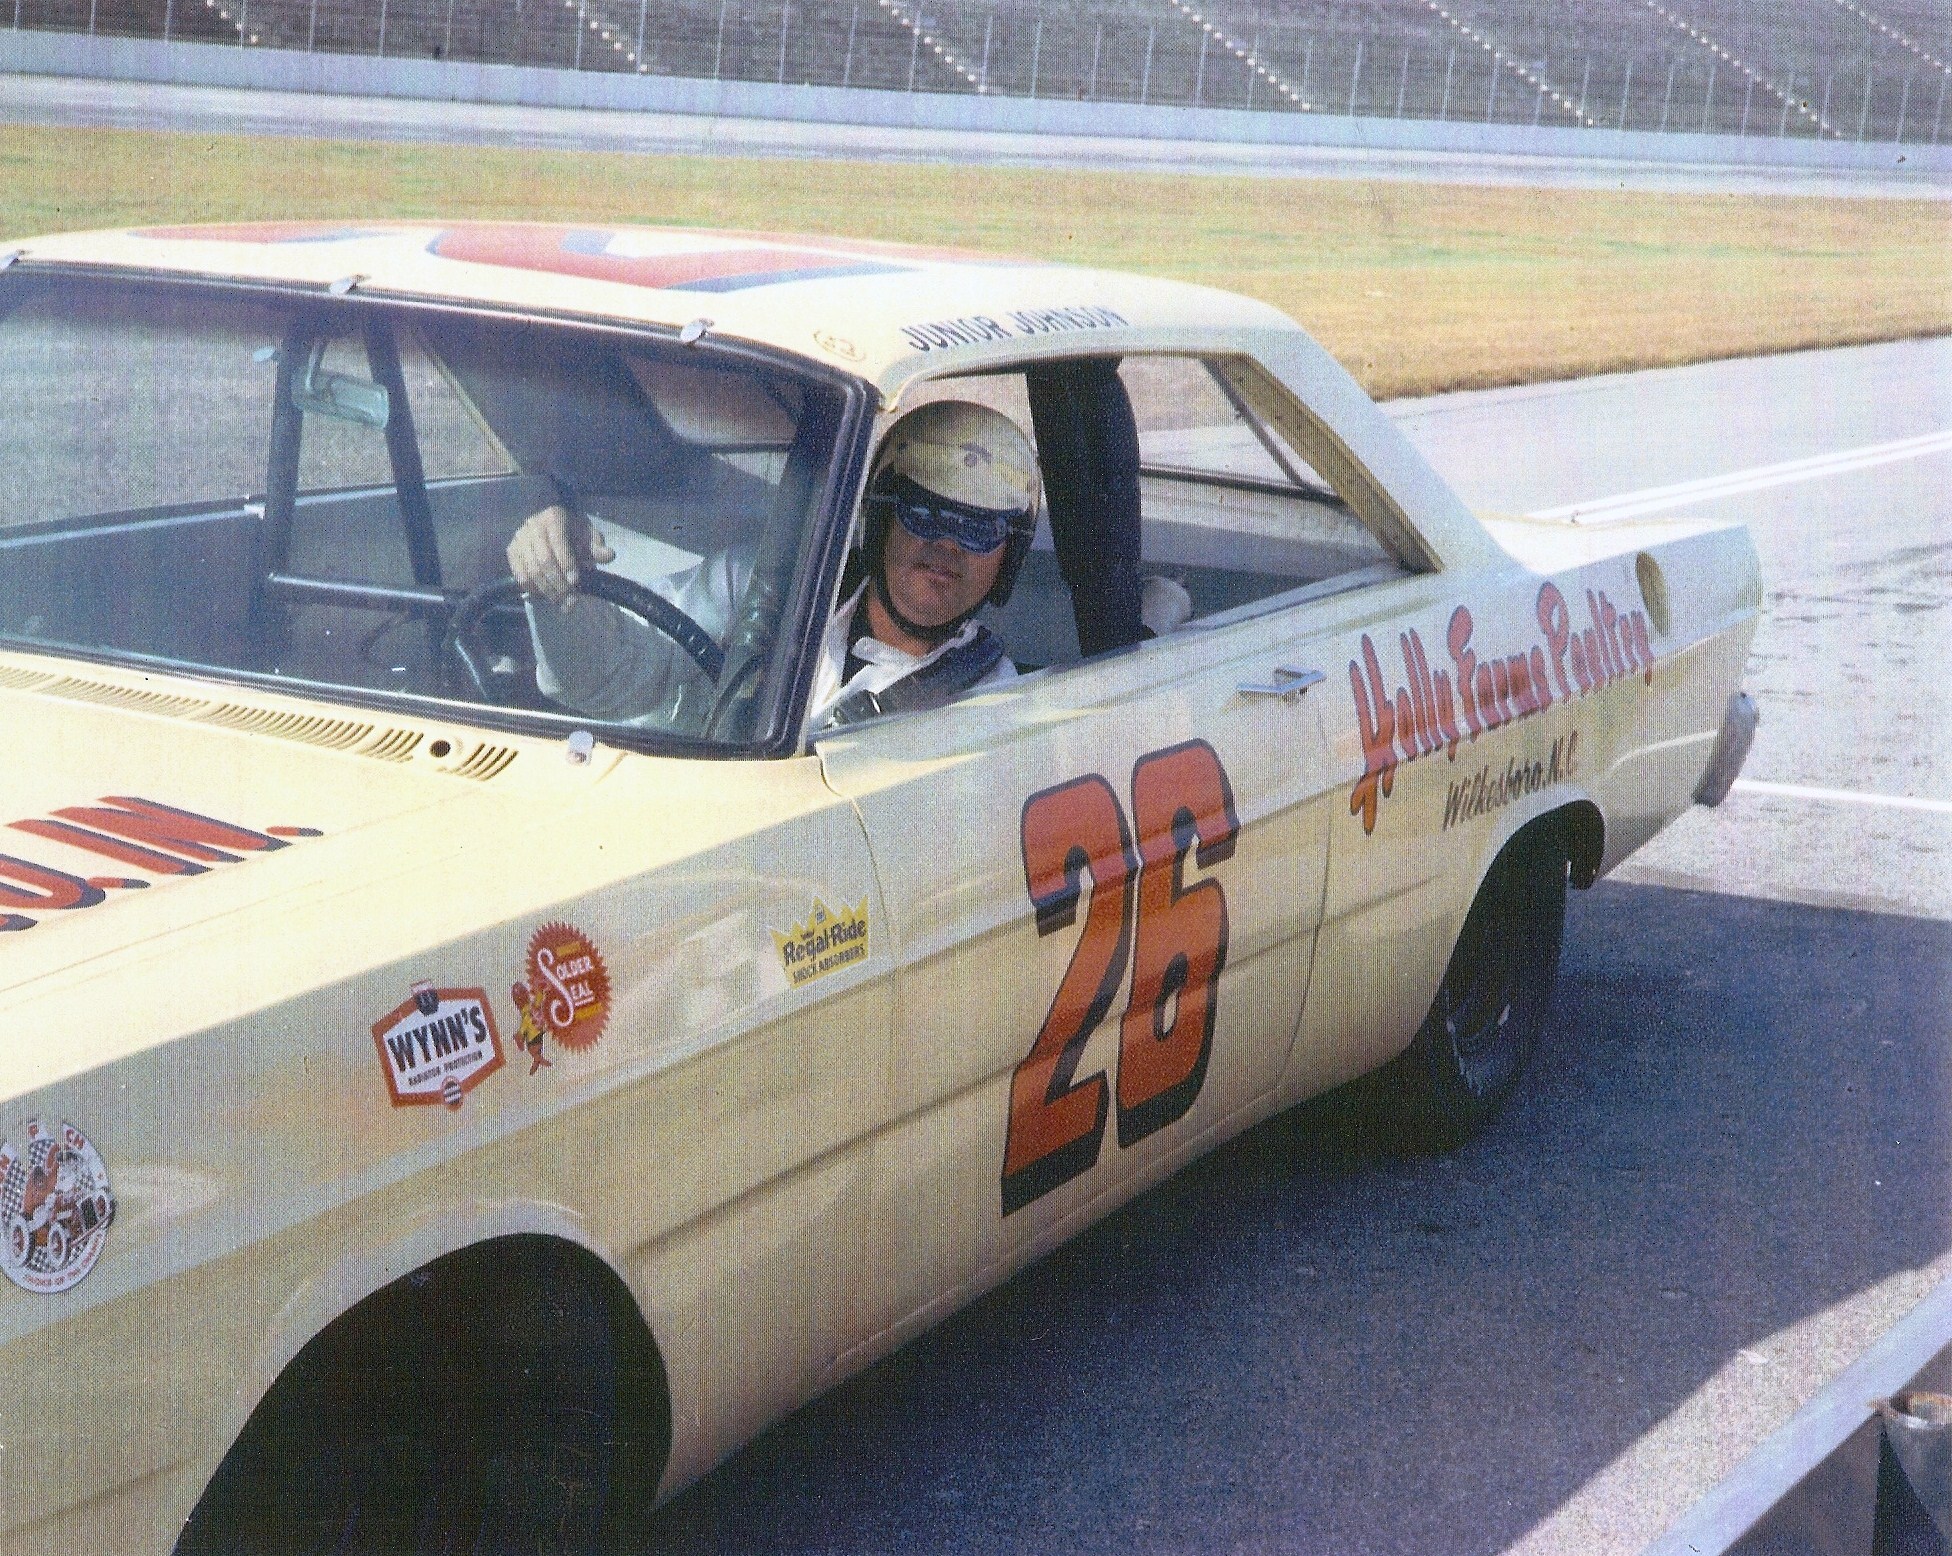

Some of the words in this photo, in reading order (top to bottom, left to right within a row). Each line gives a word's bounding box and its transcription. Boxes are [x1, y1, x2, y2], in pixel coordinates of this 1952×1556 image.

[901, 315, 1012, 352] JUNIOR
[1005, 306, 1130, 336] JOHNSON
[1349, 628, 1460, 836] Holly
[1447, 605, 1553, 743] Farms
[1536, 581, 1655, 703] Poultry
[783, 928, 829, 966] Regal
[830, 918, 866, 947] Ride
[1000, 738, 1241, 1218] 26
[387, 1006, 488, 1073] WYNN'S
